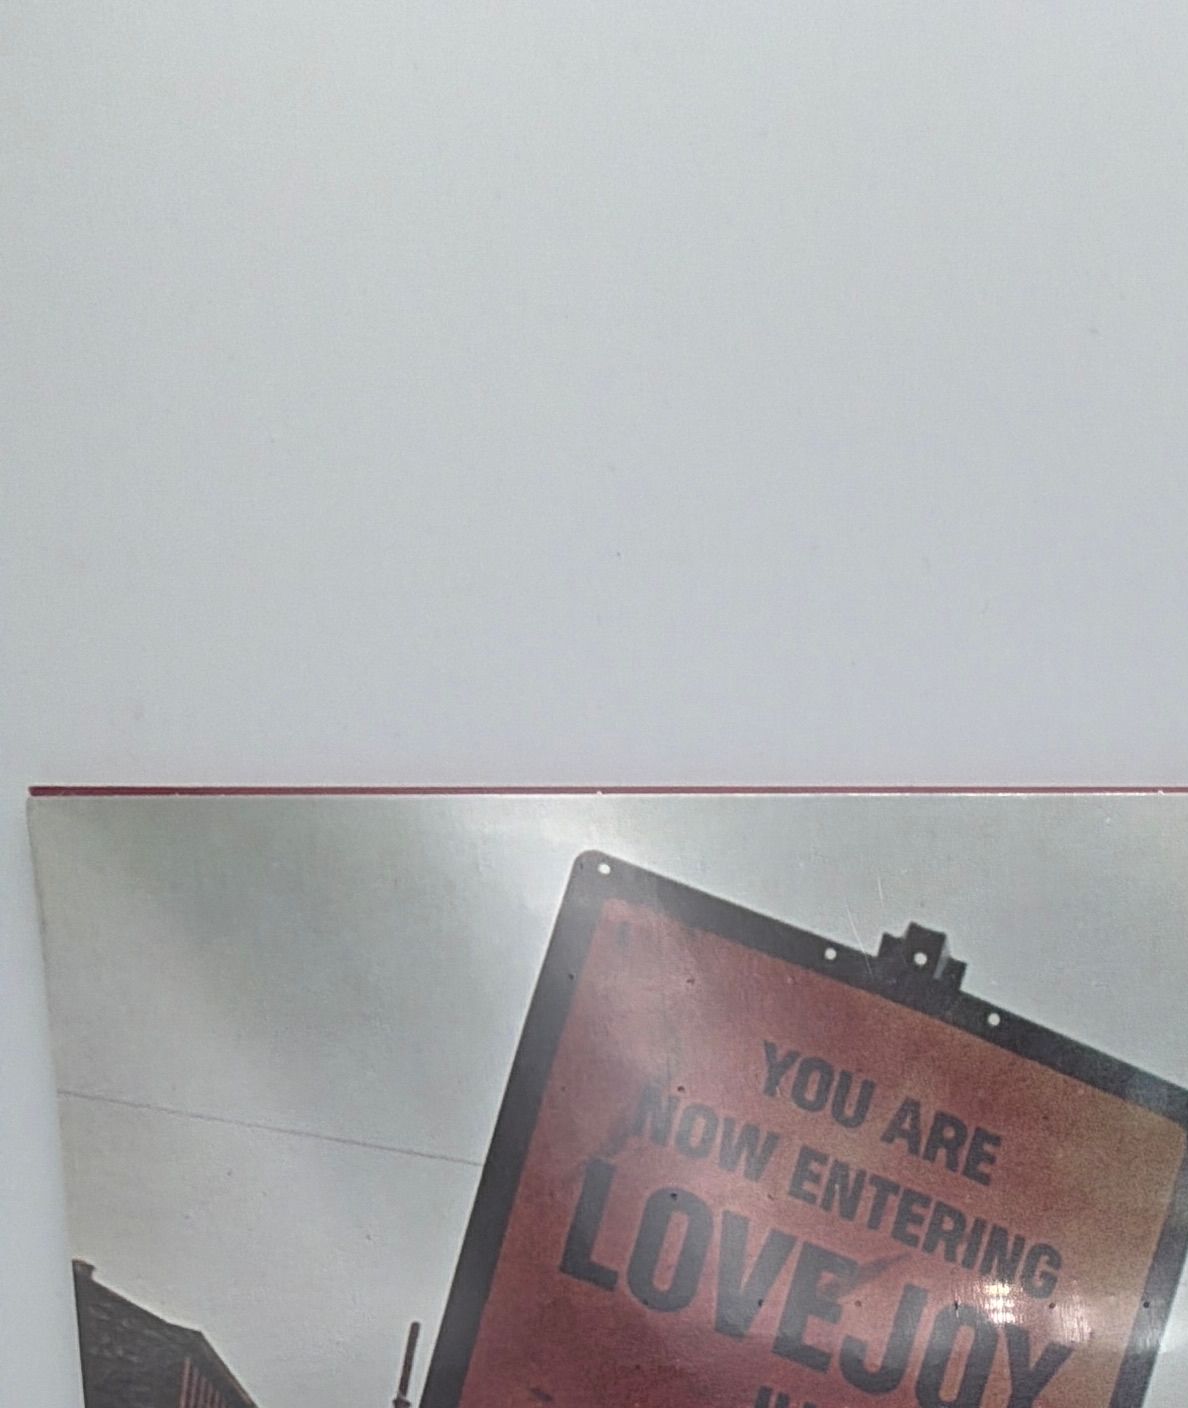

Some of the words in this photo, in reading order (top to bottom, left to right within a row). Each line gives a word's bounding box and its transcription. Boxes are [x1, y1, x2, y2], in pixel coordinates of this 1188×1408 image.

[629, 1083, 780, 1182] NOW
[786, 1145, 1063, 1300] ENTERING
[762, 1040, 876, 1129] YOU
[880, 1098, 1004, 1186] ARE
